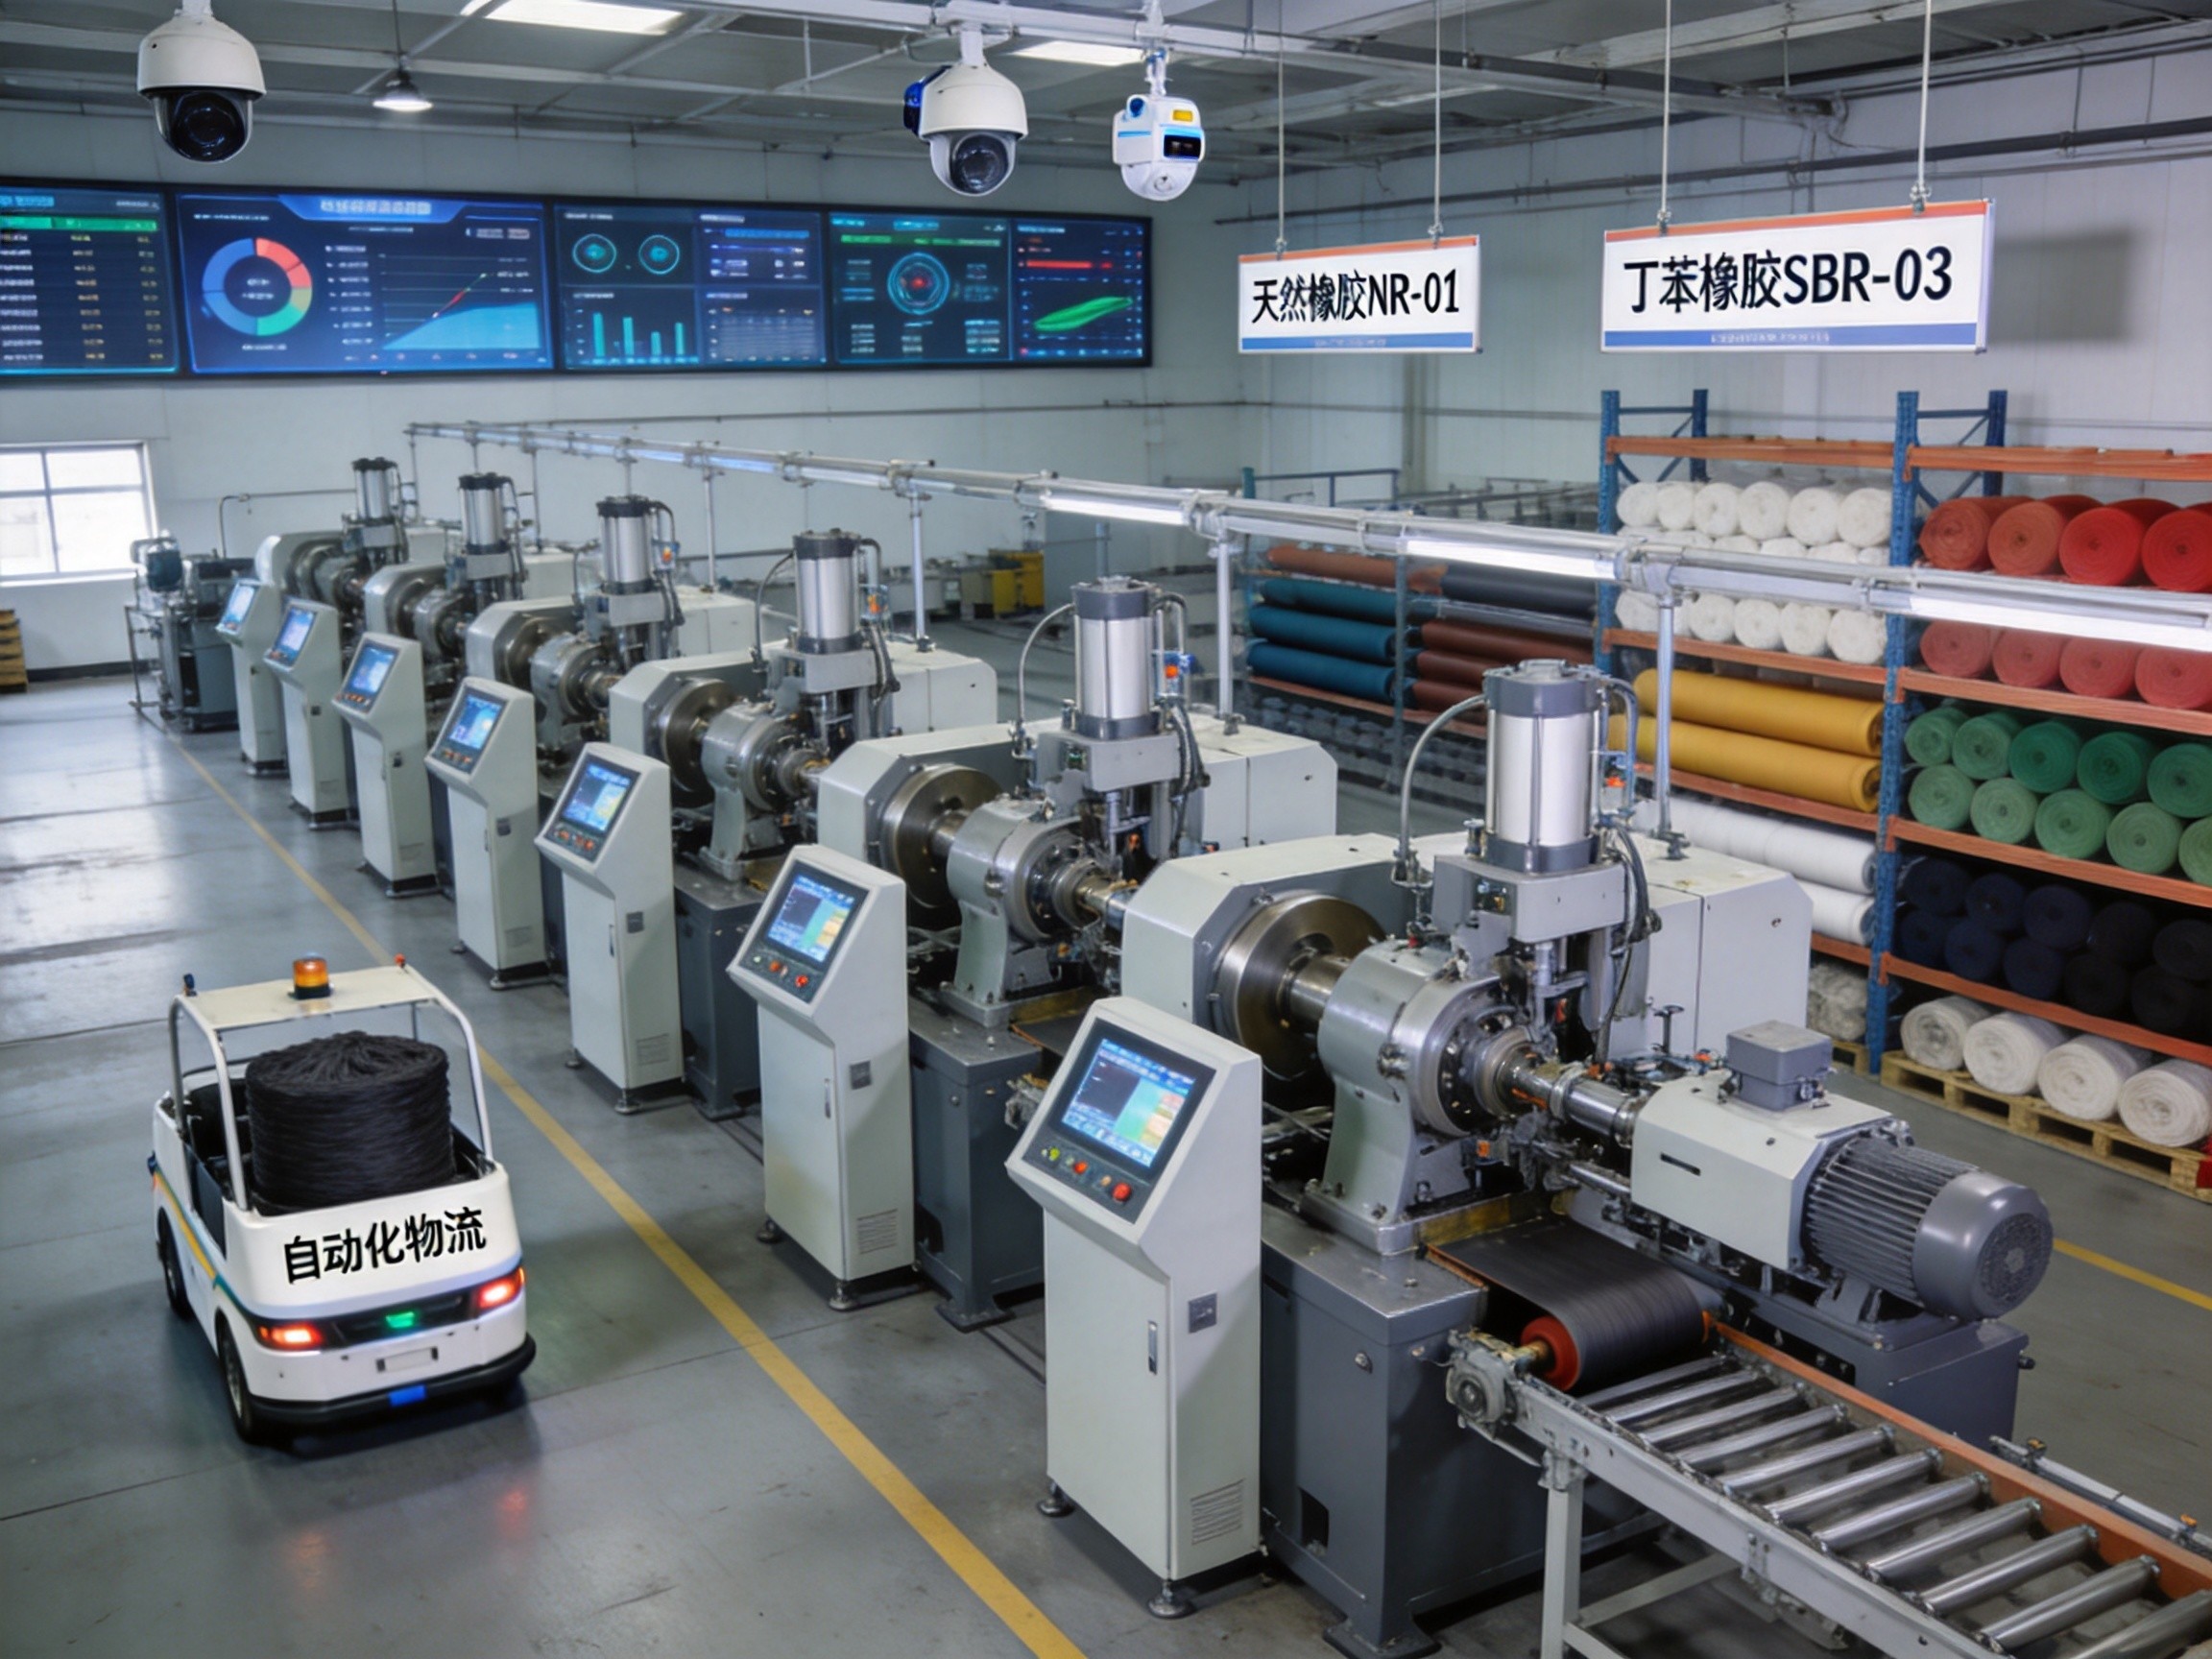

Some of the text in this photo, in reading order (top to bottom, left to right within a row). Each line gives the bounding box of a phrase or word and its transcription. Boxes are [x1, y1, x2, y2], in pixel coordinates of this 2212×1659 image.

[1252, 268, 1459, 324] 天然橡胶NR-01
[1623, 245, 1953, 314] 丁苯橡胶SBR-03
[284, 1206, 487, 1285] 自动化物流
